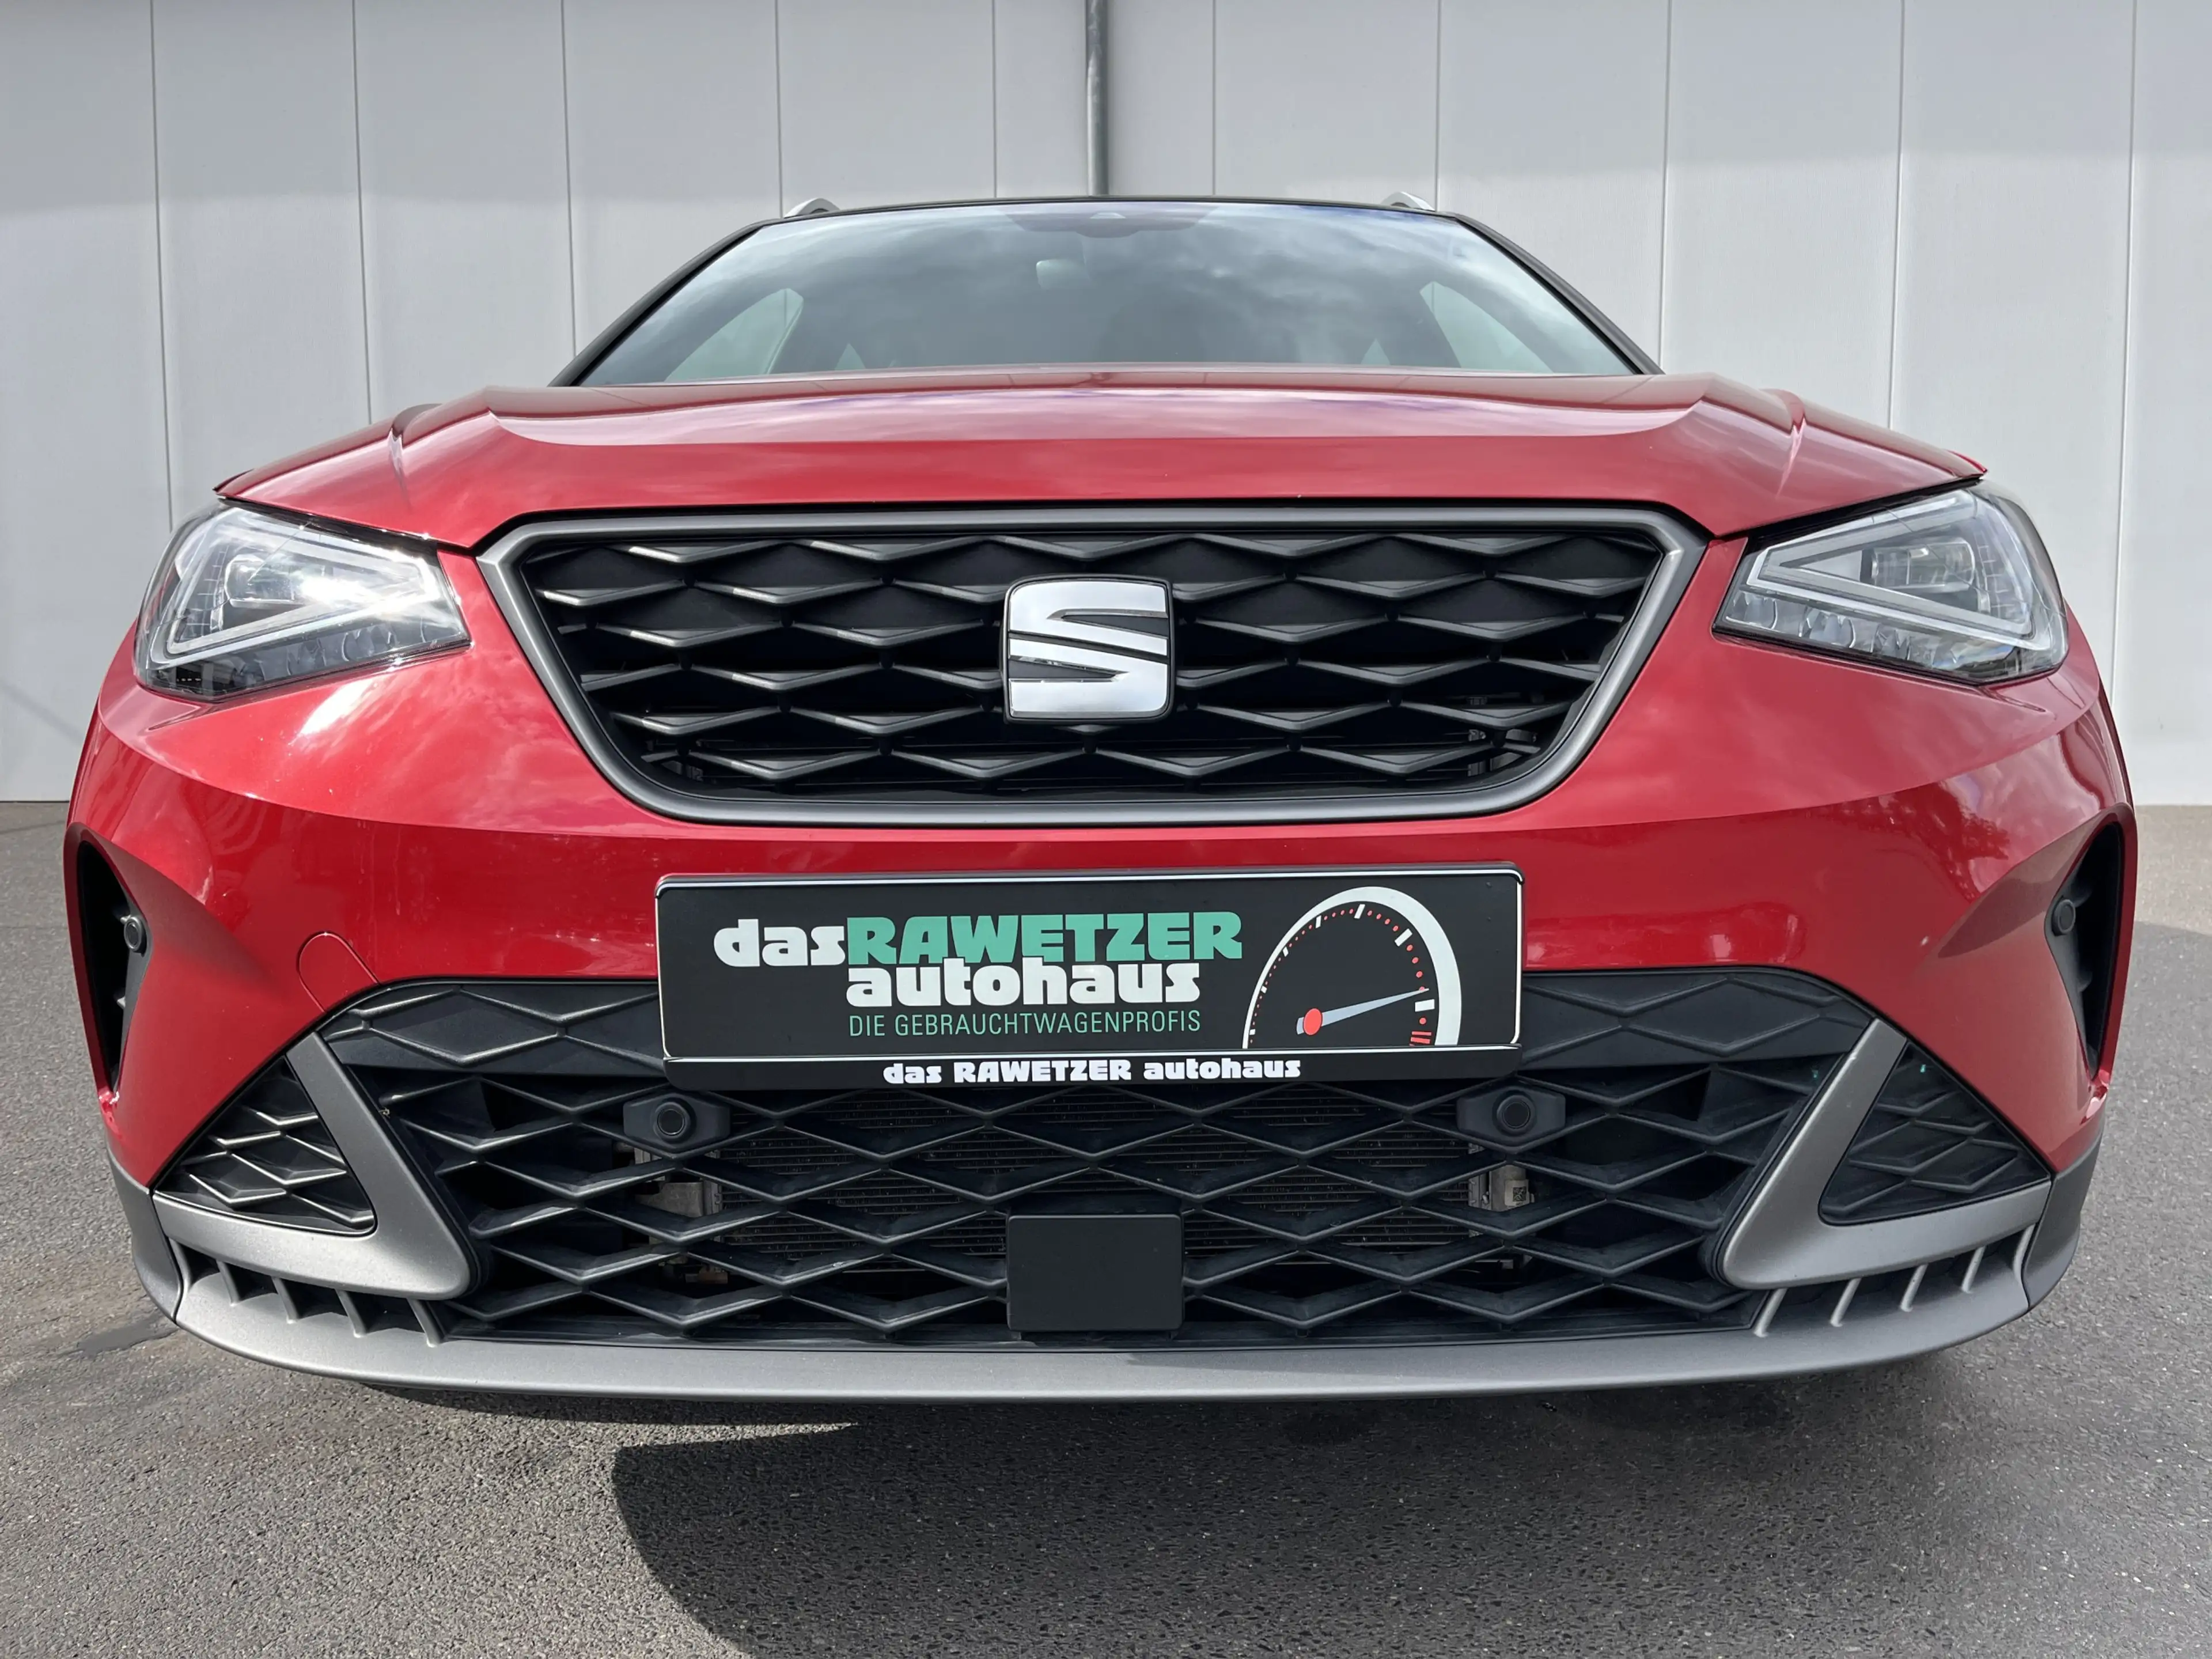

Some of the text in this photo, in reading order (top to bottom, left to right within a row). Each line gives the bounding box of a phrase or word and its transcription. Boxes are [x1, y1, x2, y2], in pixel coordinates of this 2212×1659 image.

[846, 957, 1200, 1007] autohaus
[850, 1010, 1200, 1036] DIE GEBRAUCHTWAGENPROFIS
[882, 1058, 1301, 1084] das RAWETZER autohaus
